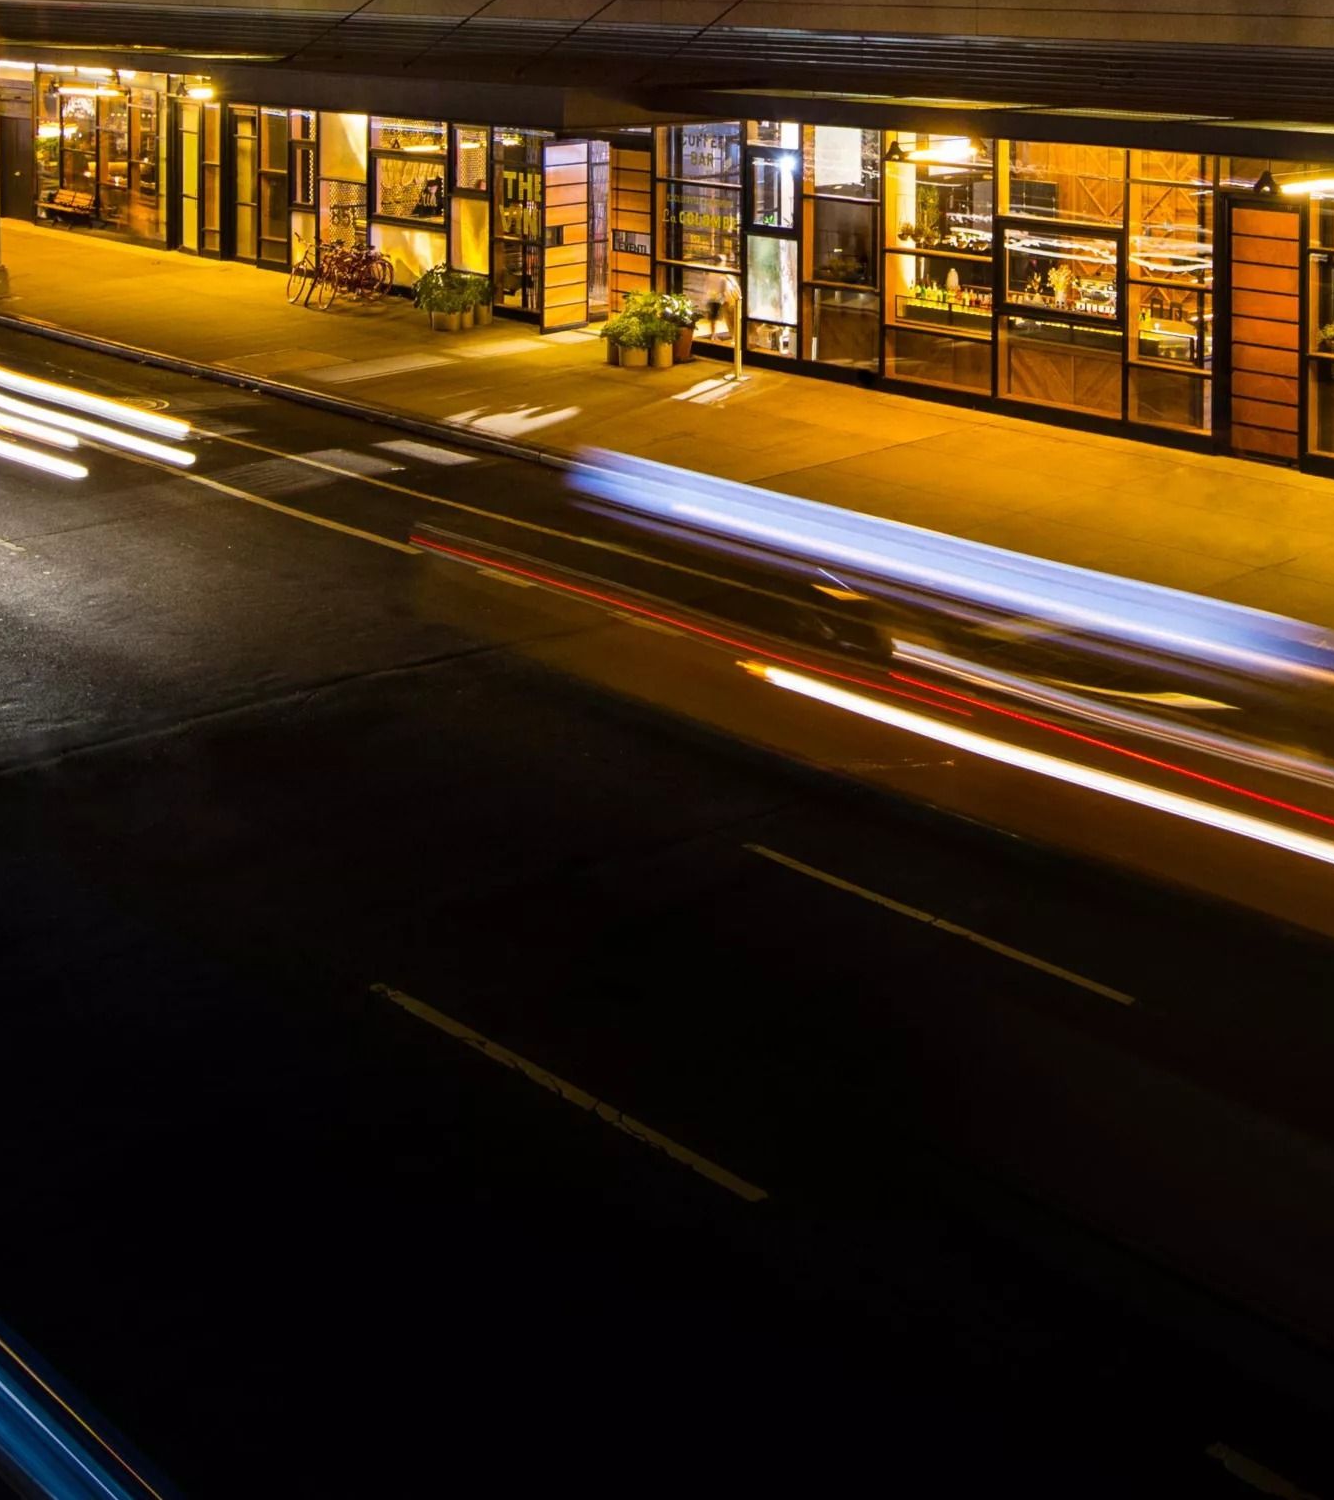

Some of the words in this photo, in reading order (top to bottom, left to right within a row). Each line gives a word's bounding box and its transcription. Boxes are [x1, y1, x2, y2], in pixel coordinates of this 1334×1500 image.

[690, 151, 714, 168] BAR
[503, 170, 542, 202] THE
[499, 203, 542, 237] VIN
